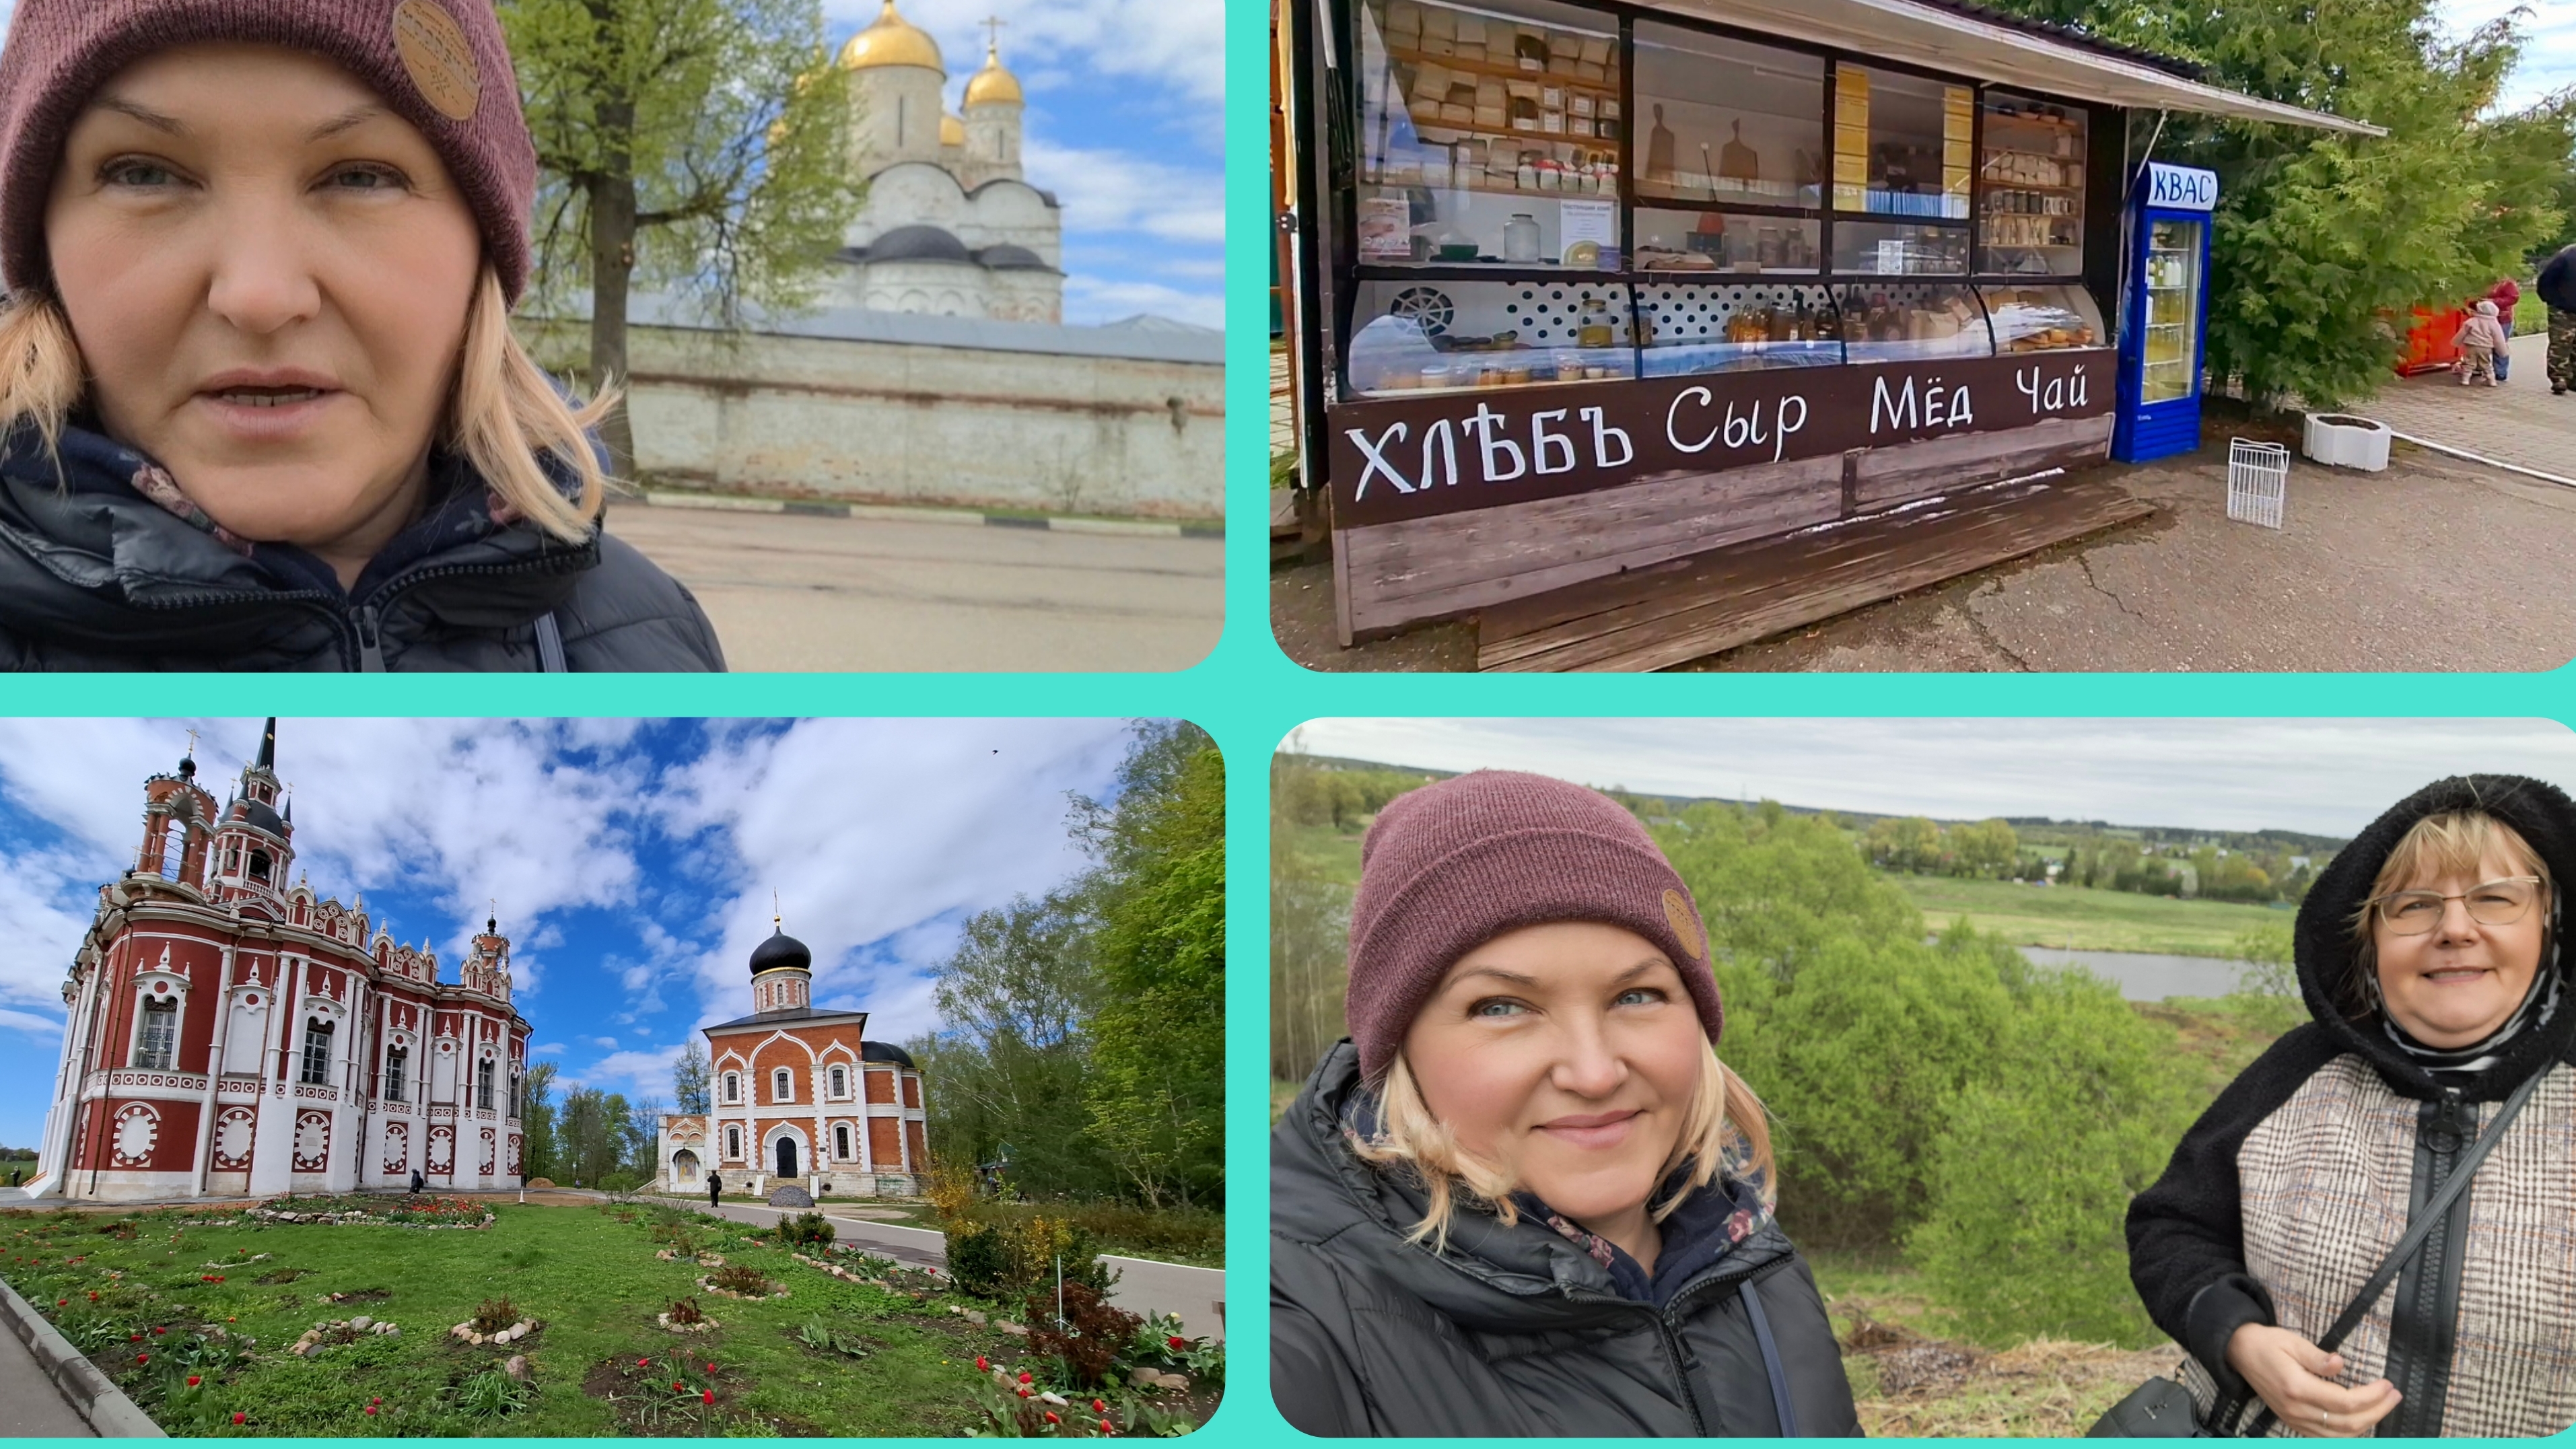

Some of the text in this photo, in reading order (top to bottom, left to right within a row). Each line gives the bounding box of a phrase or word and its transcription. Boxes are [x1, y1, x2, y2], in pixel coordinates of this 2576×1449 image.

[2154, 170, 2212, 204] КВАС
[1666, 386, 1807, 463] Сыр
[1870, 375, 1973, 433] Мёд
[2016, 363, 2088, 414] Чай
